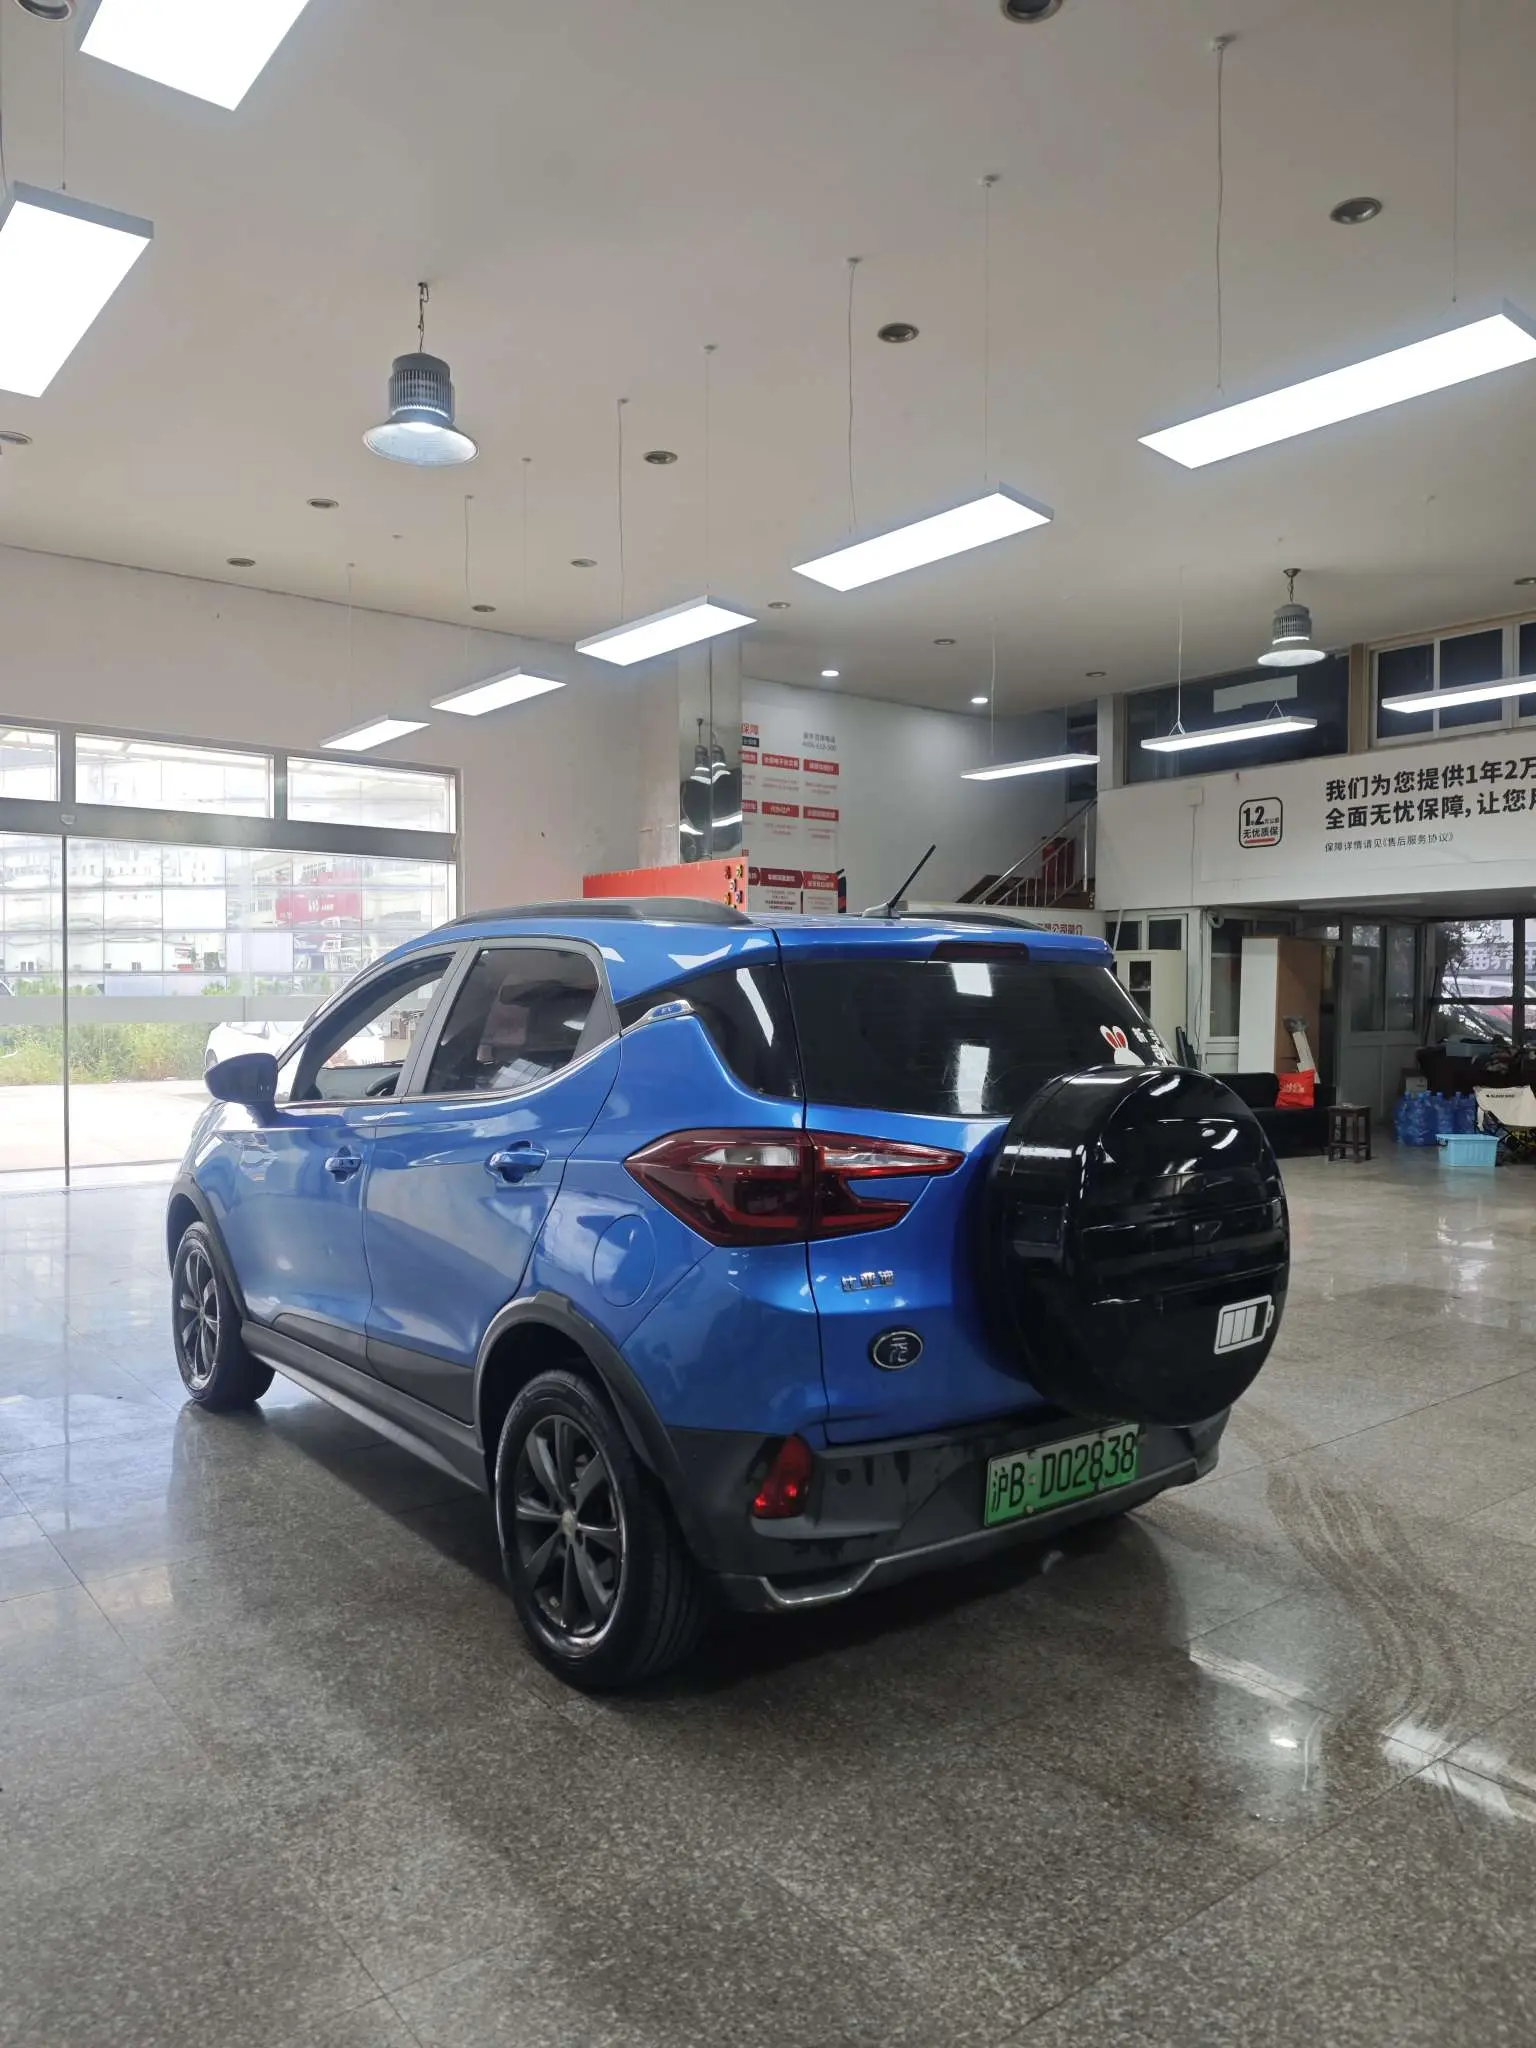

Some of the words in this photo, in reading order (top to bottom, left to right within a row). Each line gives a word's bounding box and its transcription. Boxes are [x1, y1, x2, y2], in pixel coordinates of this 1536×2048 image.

[1326, 756, 1536, 802] 我们为您提供1年2万
